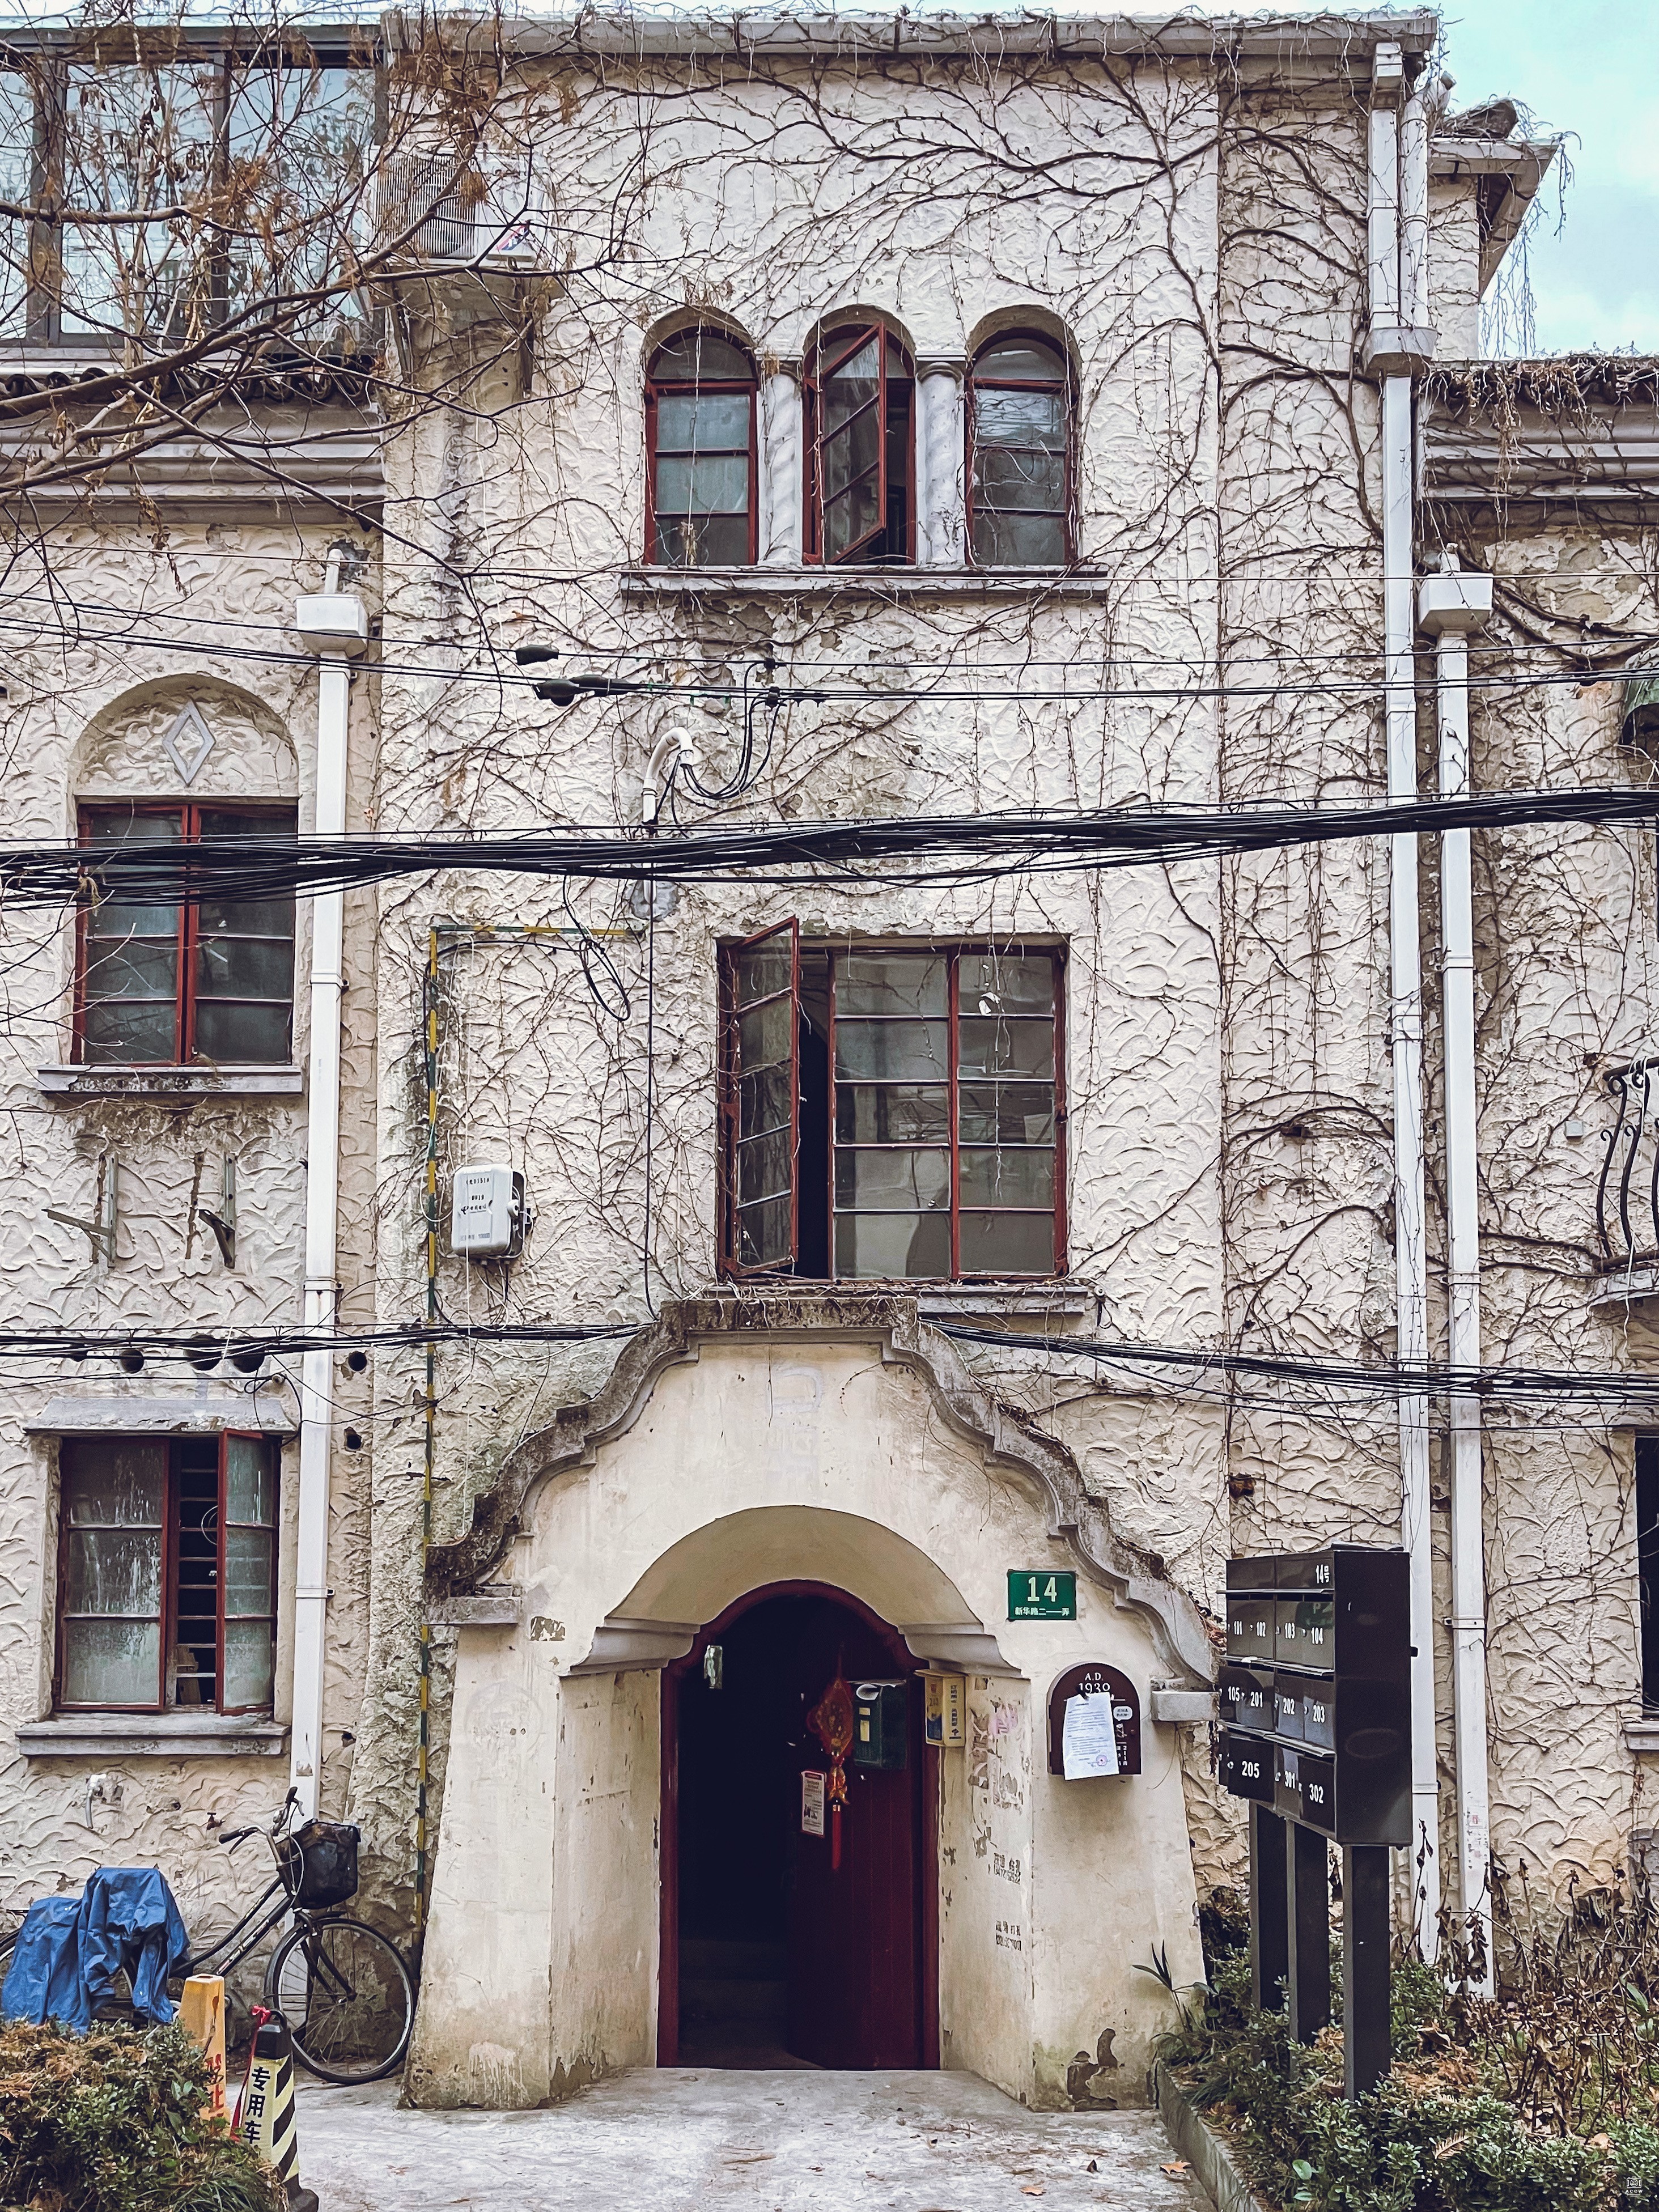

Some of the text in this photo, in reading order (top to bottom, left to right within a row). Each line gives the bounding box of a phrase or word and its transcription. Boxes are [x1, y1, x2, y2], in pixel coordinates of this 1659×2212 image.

[1315, 1564, 1330, 1584] 14号
[1027, 1577, 1058, 1602] 14
[1233, 1620, 1243, 1636] 101
[1256, 1621, 1266, 1637] 102
[1284, 1622, 1296, 1639] 103
[1311, 1627, 1323, 1645] 104
[1085, 1672, 1104, 1681] A.D.
[1079, 1683, 1111, 1694] 1930
[1228, 1685, 1240, 1702] 105
[1250, 1691, 1263, 1708] 201
[1282, 1697, 1296, 1716] 202
[1313, 1705, 1326, 1723] 203
[1241, 1760, 1261, 1779] 205
[1284, 1770, 1296, 1789] 301
[1308, 1783, 1324, 1805] 302
[242, 2066, 271, 2145] 专用车
